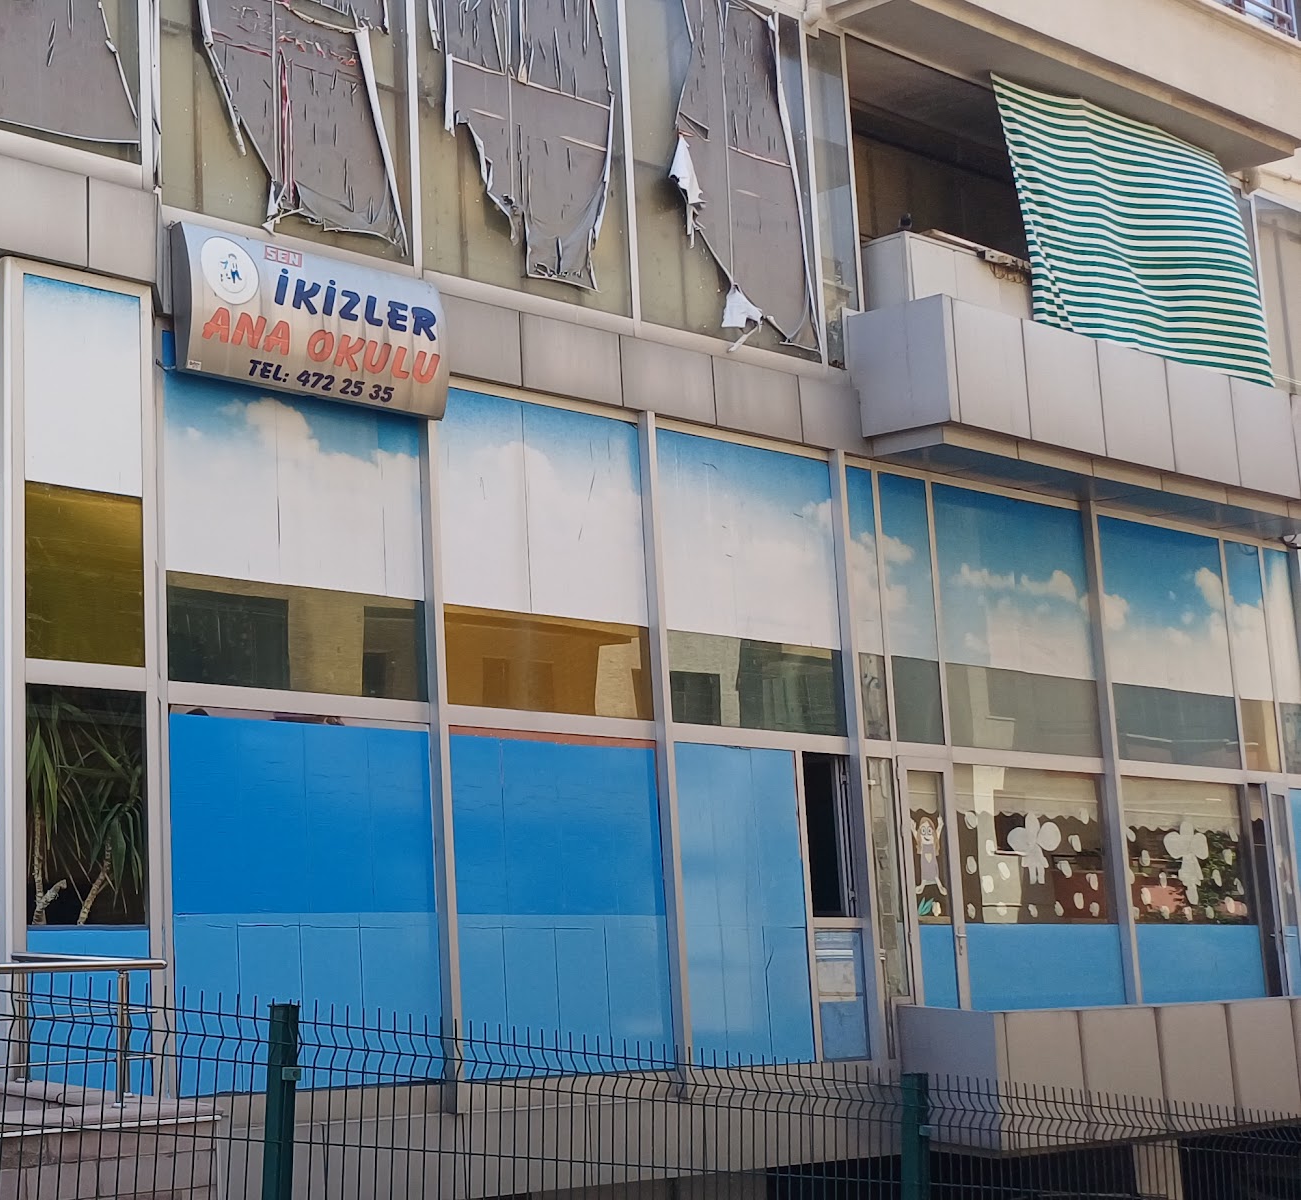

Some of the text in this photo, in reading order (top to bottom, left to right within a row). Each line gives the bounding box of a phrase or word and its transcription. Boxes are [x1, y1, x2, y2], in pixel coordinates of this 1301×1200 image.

[274, 268, 437, 342] İKİZLER
[201, 307, 440, 384] ANA OKULU
[248, 359, 394, 403] TEL: 472 25 35
